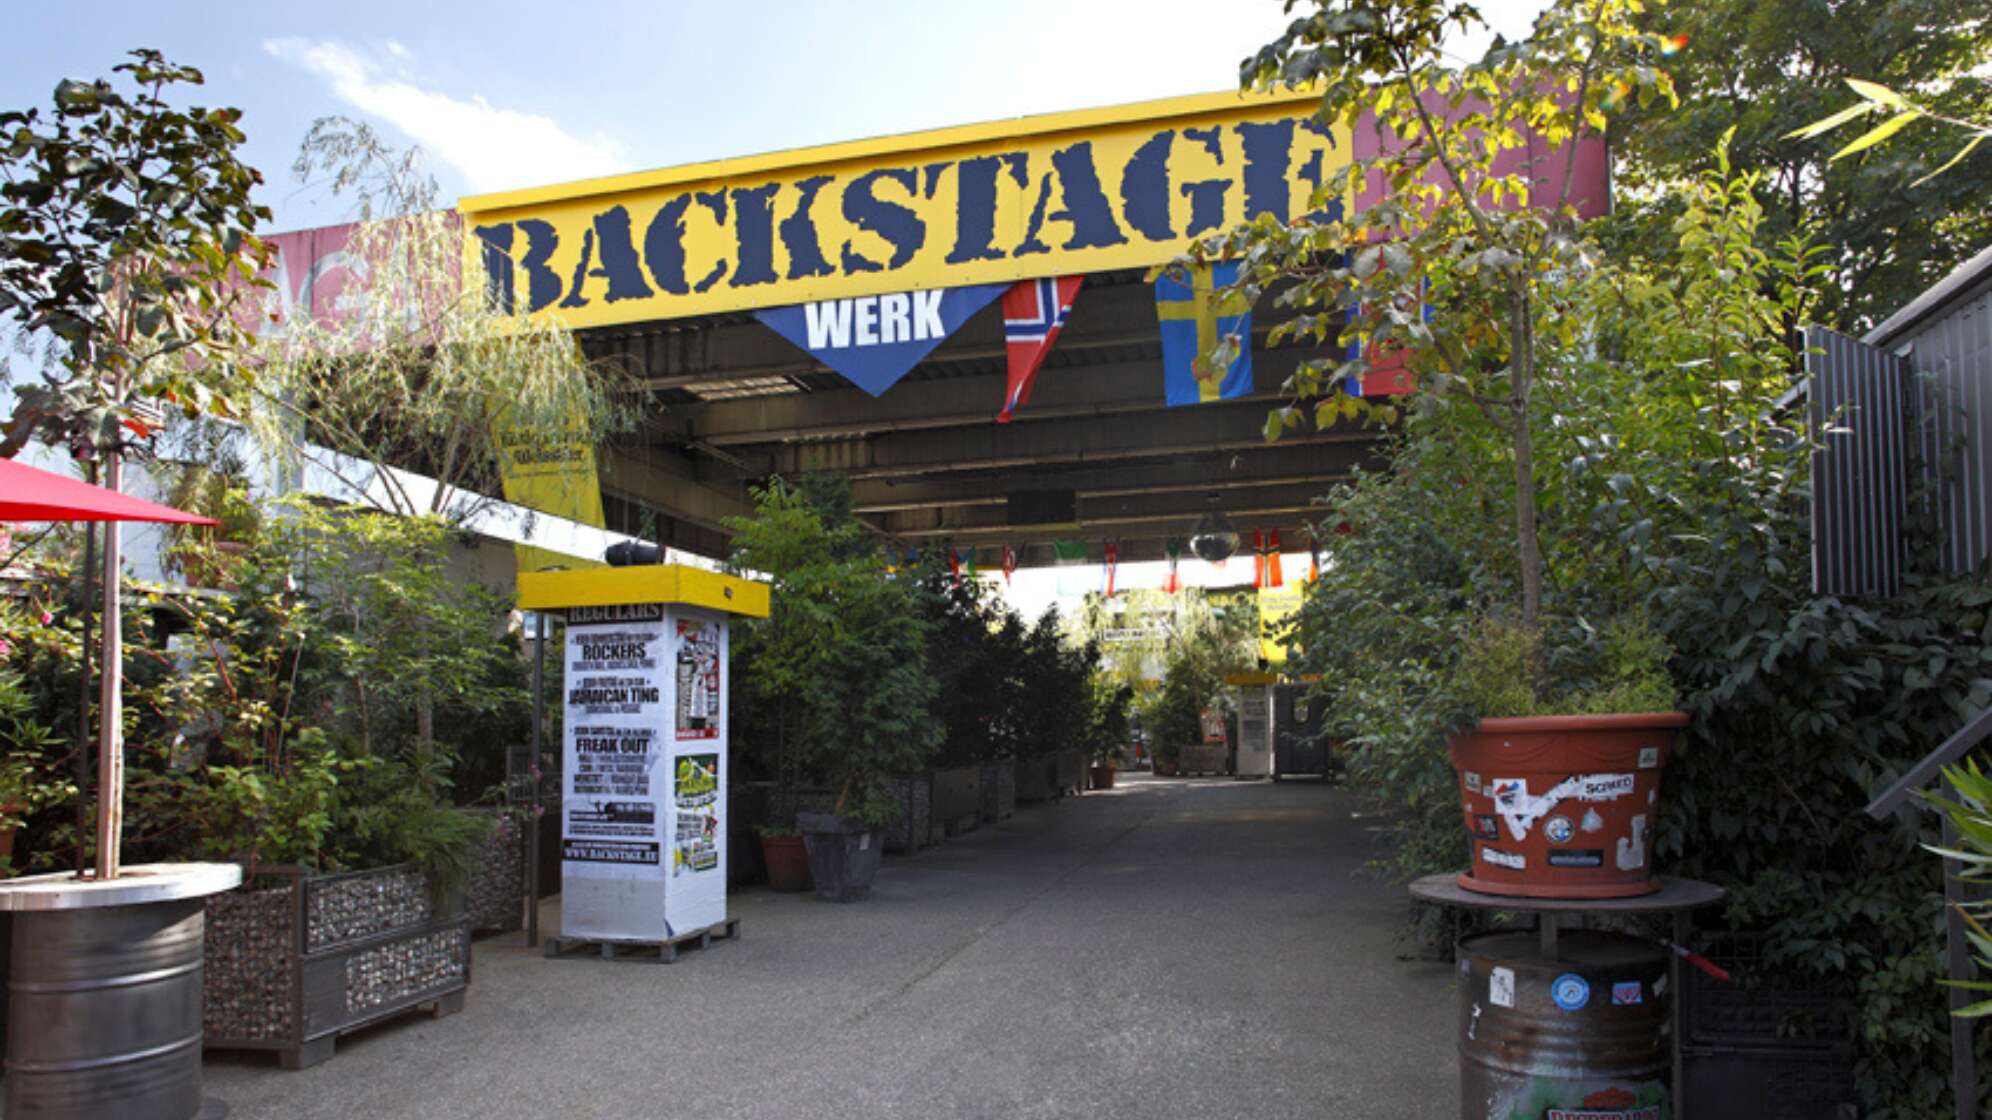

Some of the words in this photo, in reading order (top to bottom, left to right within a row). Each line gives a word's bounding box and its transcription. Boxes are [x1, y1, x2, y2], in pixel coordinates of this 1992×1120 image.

[474, 118, 1344, 317] BACKSTAGE
[804, 289, 946, 350] WERK
[583, 642, 646, 660] ROCKERS
[631, 687, 659, 703] TING
[576, 738, 617, 753] FREAK
[621, 738, 650, 753] OUT
